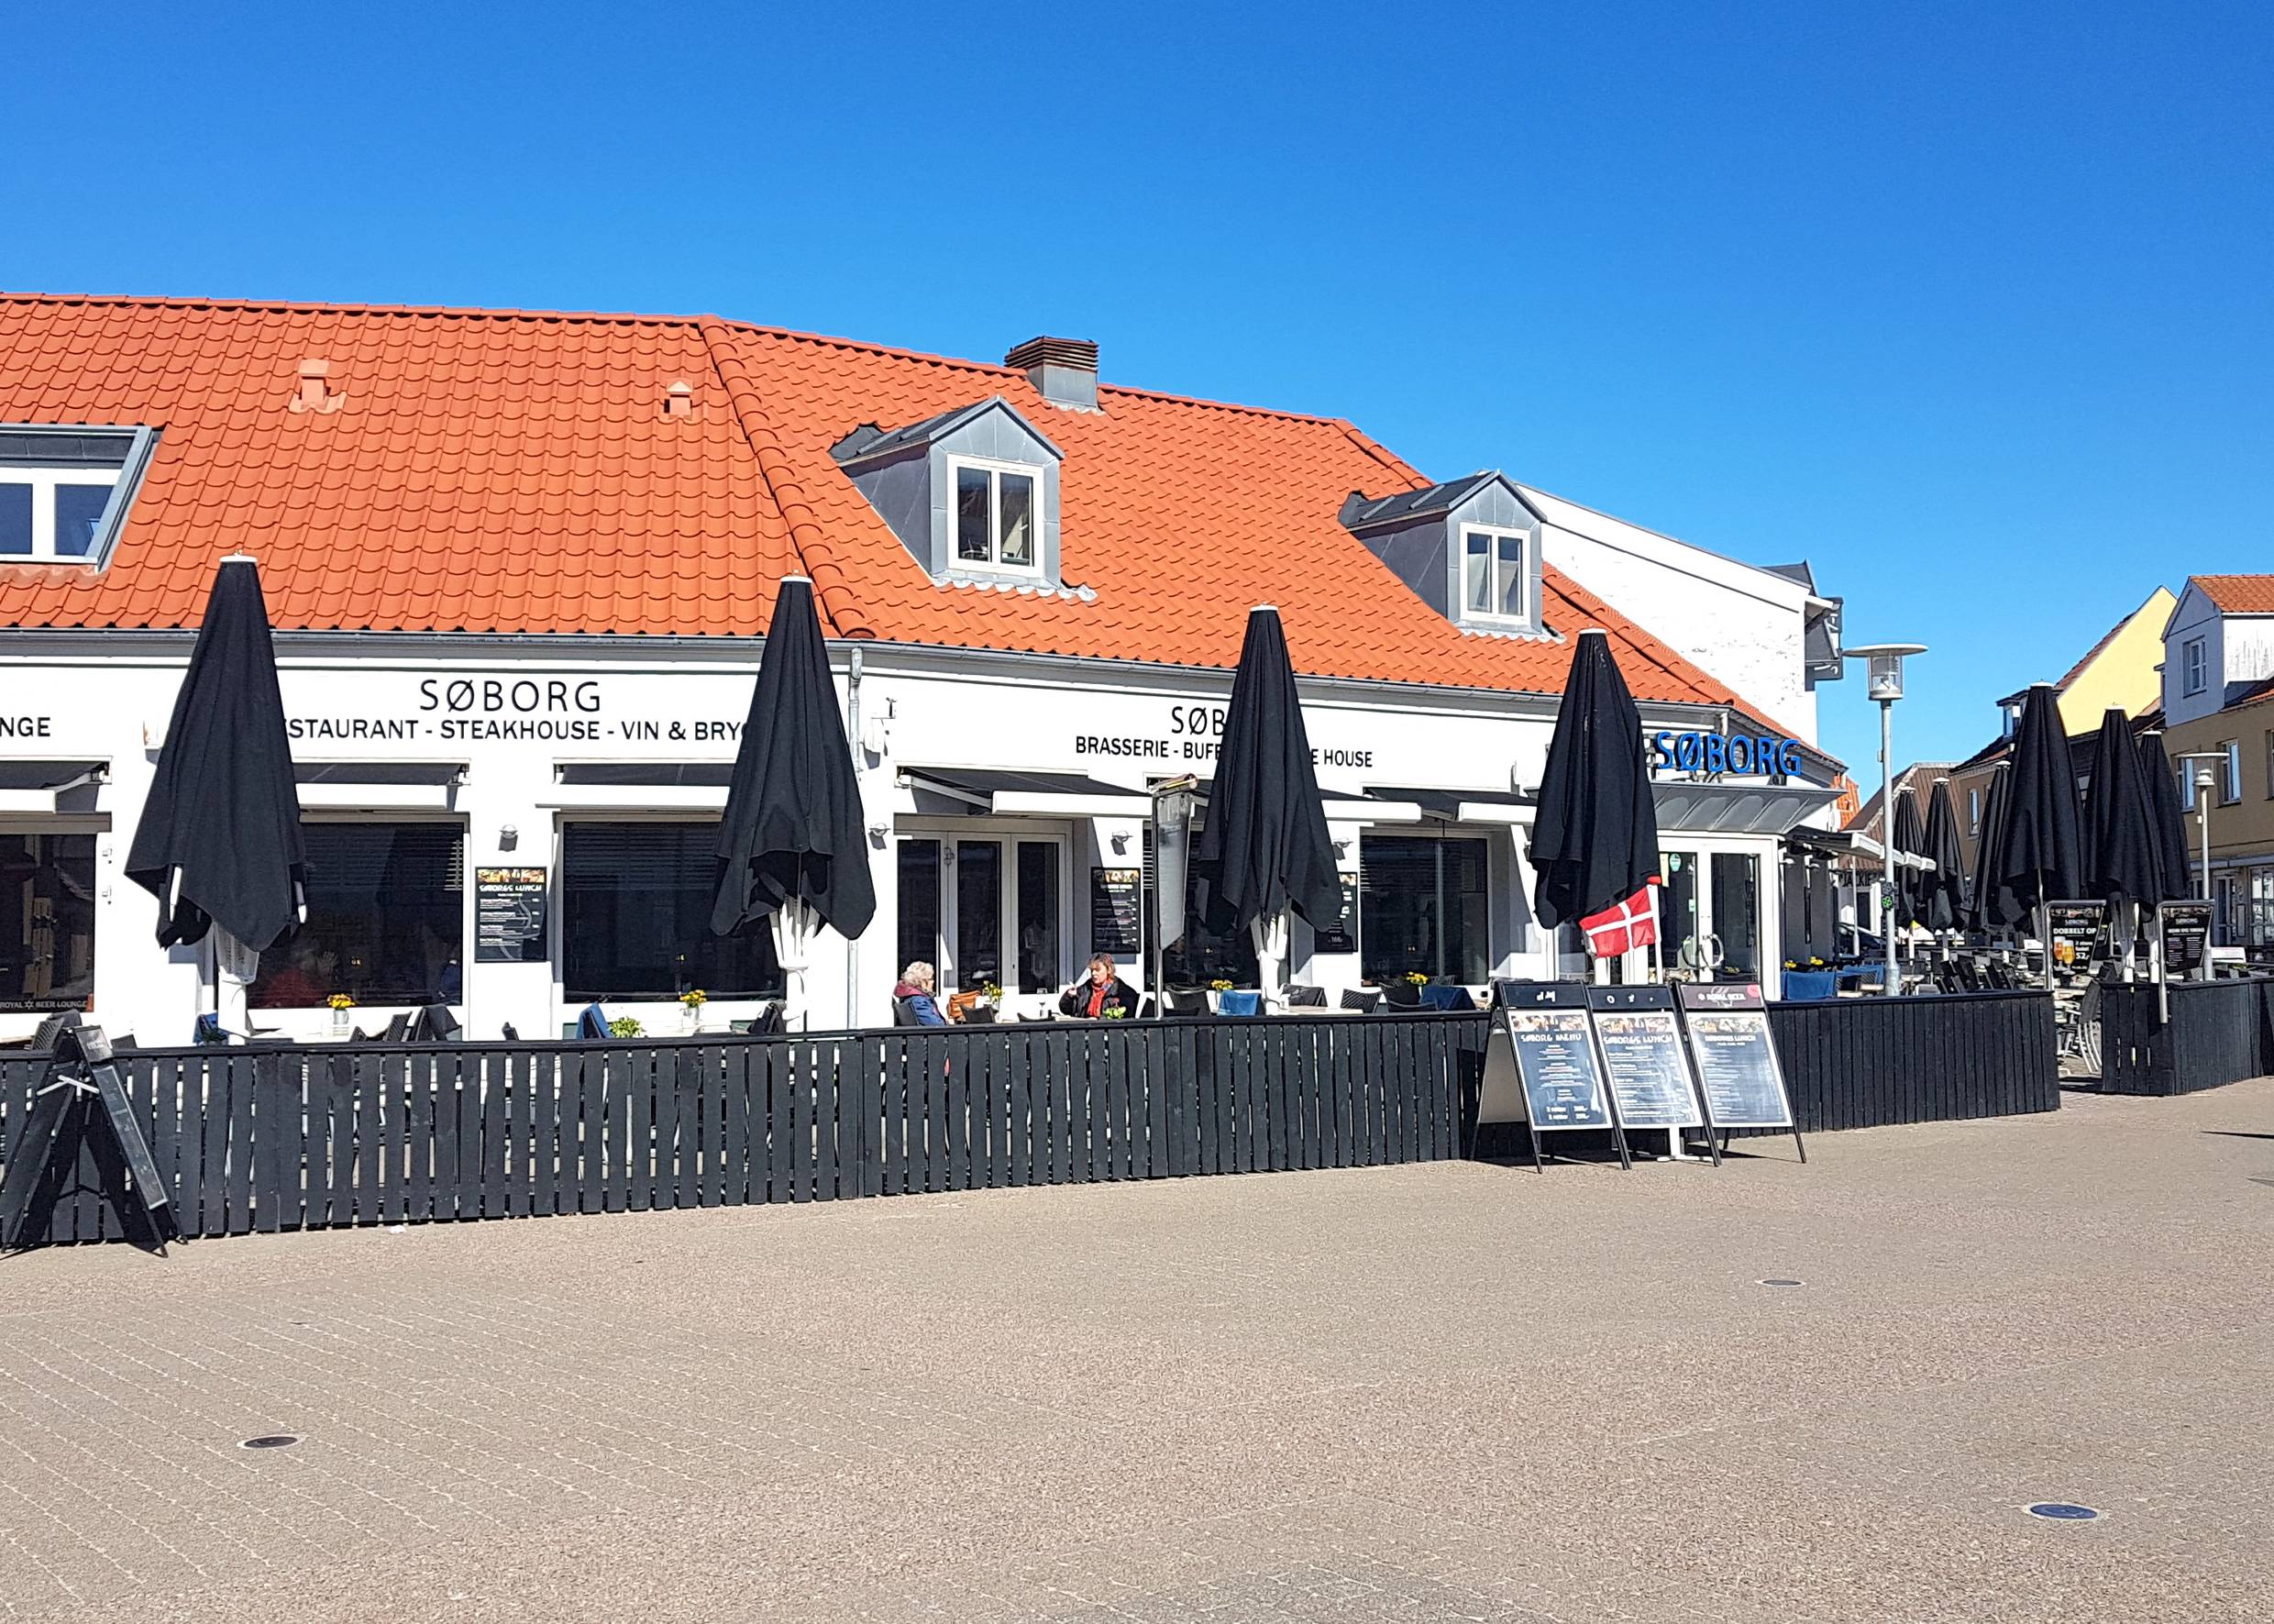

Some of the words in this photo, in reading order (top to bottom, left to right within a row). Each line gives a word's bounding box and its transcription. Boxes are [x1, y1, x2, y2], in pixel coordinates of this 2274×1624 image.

[420, 679, 601, 713] SØBORG
[284, 718, 419, 738] STAURANT
[440, 719, 601, 740] STEAKHOUSE
[621, 721, 658, 740] VIN
[668, 721, 687, 740] &
[694, 721, 747, 741] BRY
[1076, 735, 1169, 758] BRASSERIE
[1324, 748, 1373, 768] HOUSE
[1656, 731, 1803, 776] SØBORG
